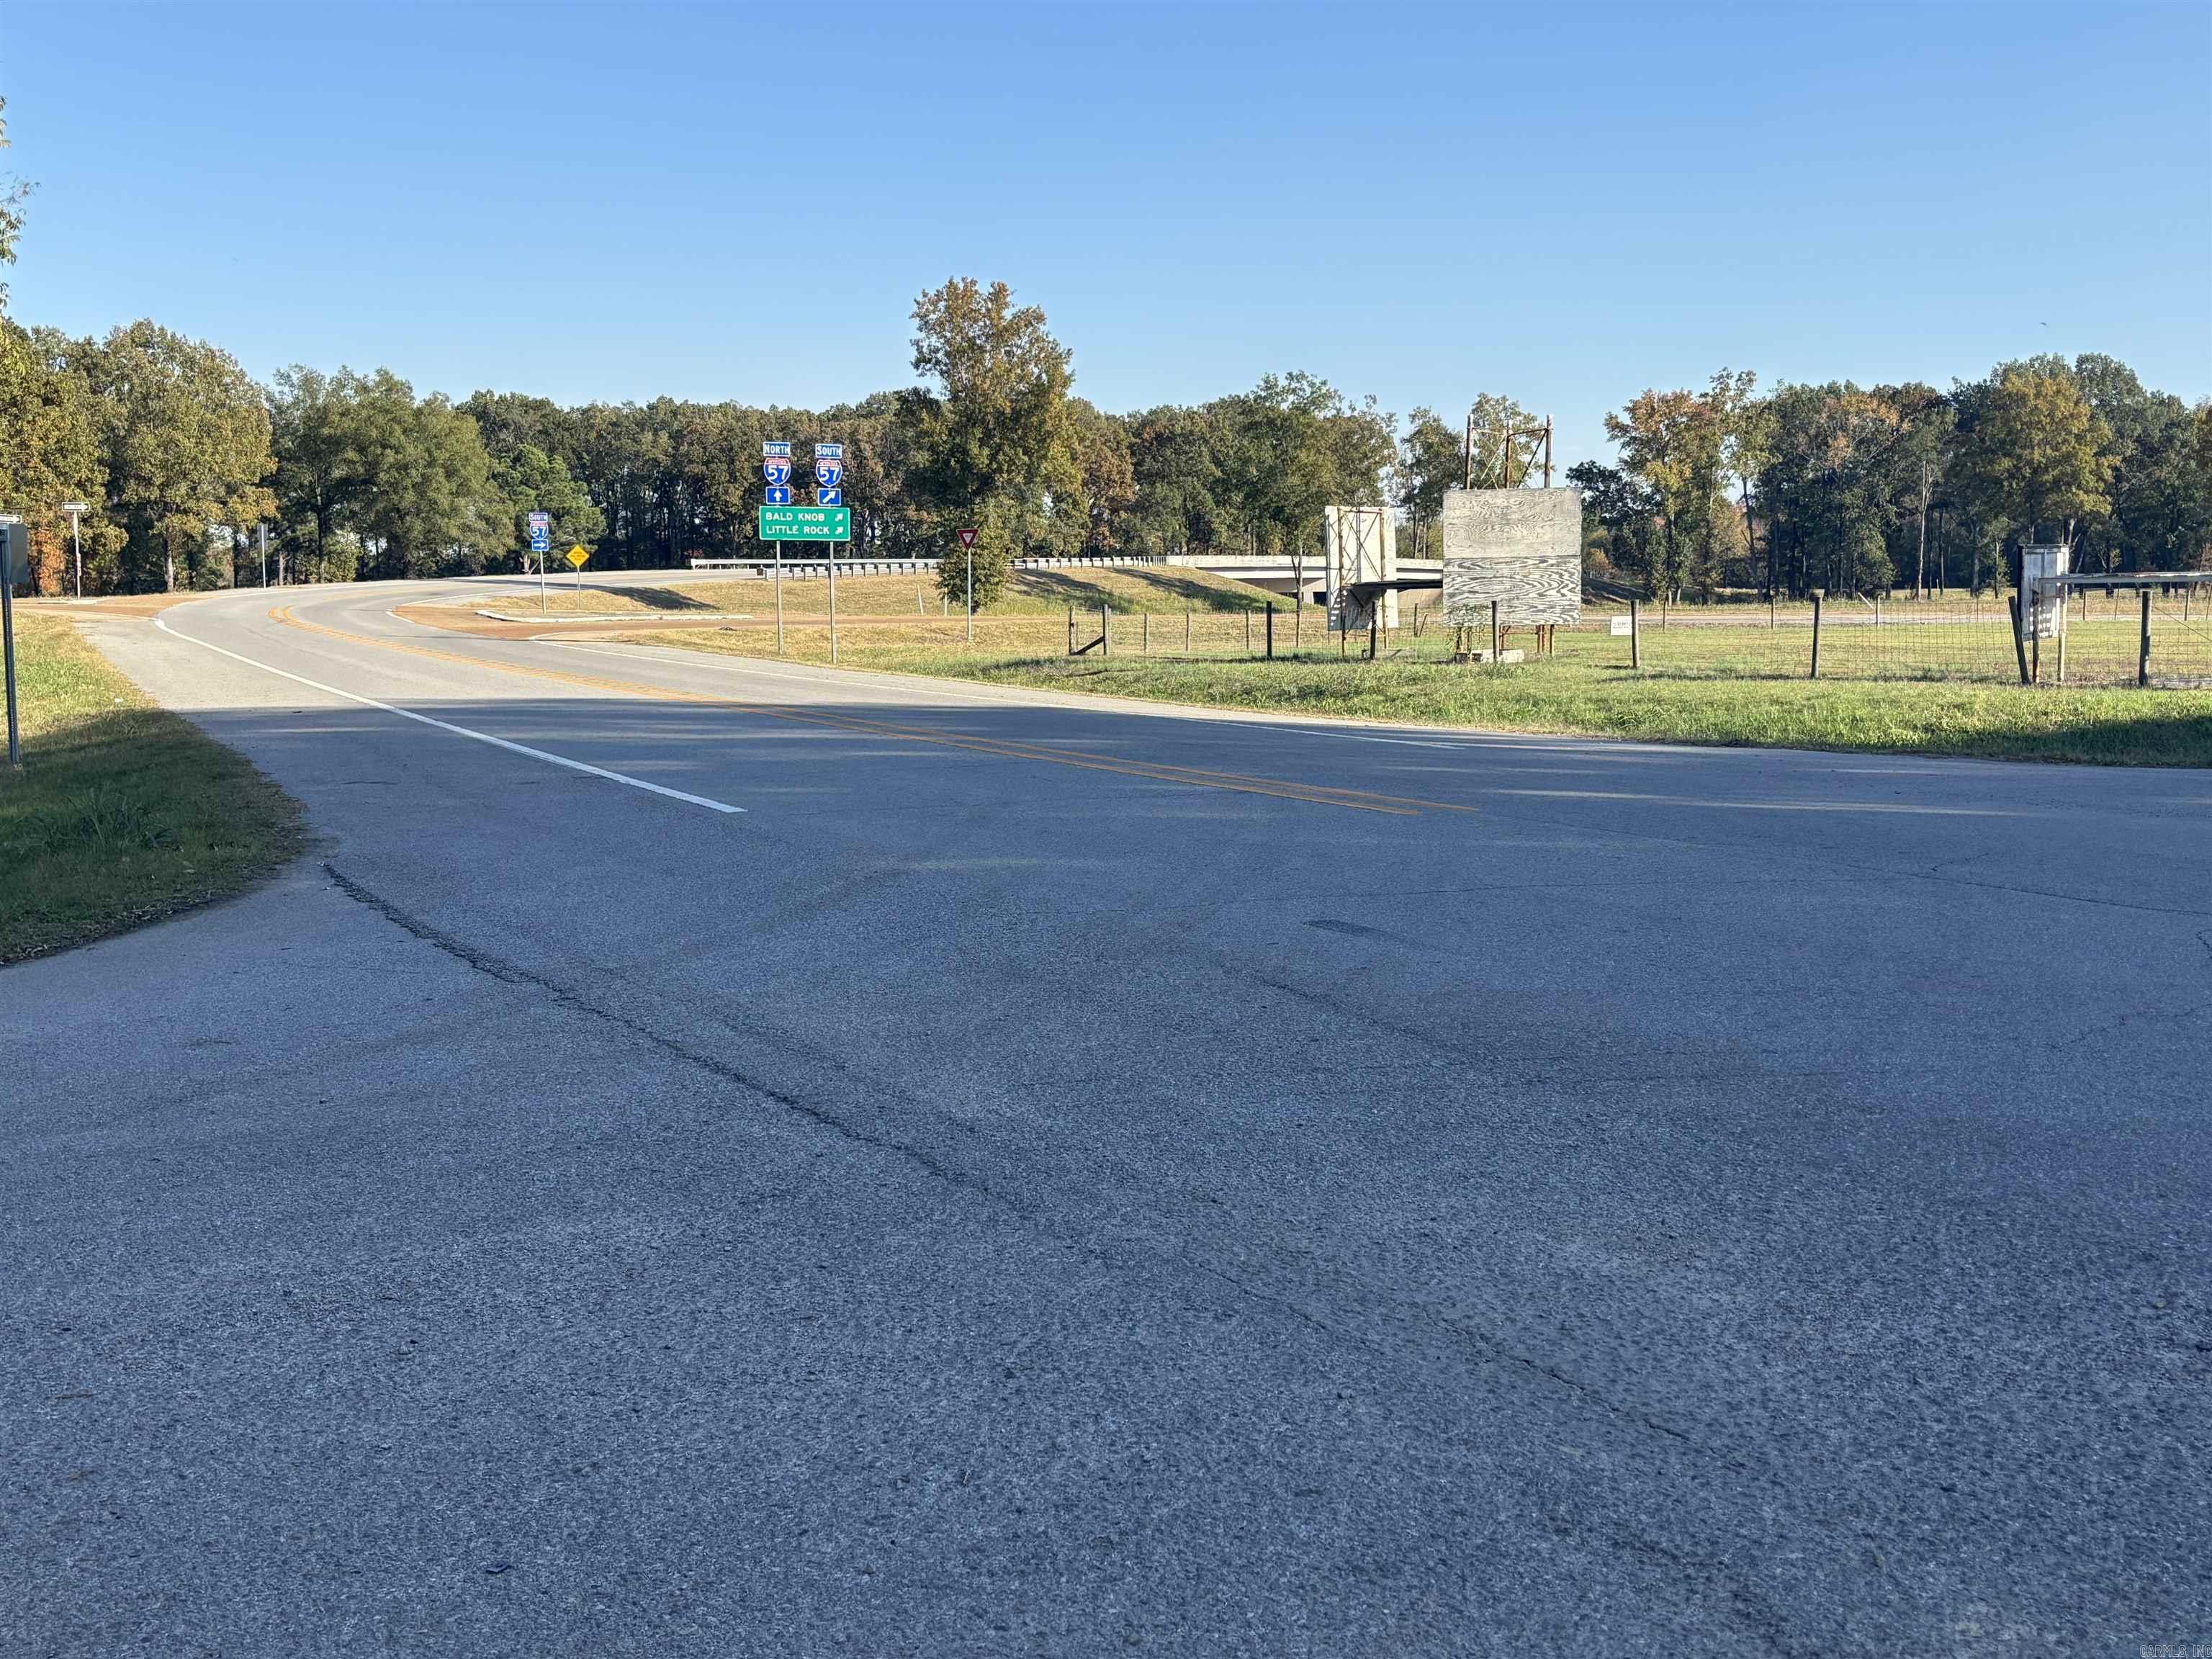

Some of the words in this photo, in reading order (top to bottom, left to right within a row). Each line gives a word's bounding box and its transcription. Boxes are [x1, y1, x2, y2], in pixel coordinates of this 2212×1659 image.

[764, 444, 789, 454] NORTH
[817, 446, 841, 455] SOUTH
[768, 465, 788, 480] 57
[819, 467, 840, 481] 57
[765, 512, 793, 521] BALD
[533, 527, 546, 536] 57
